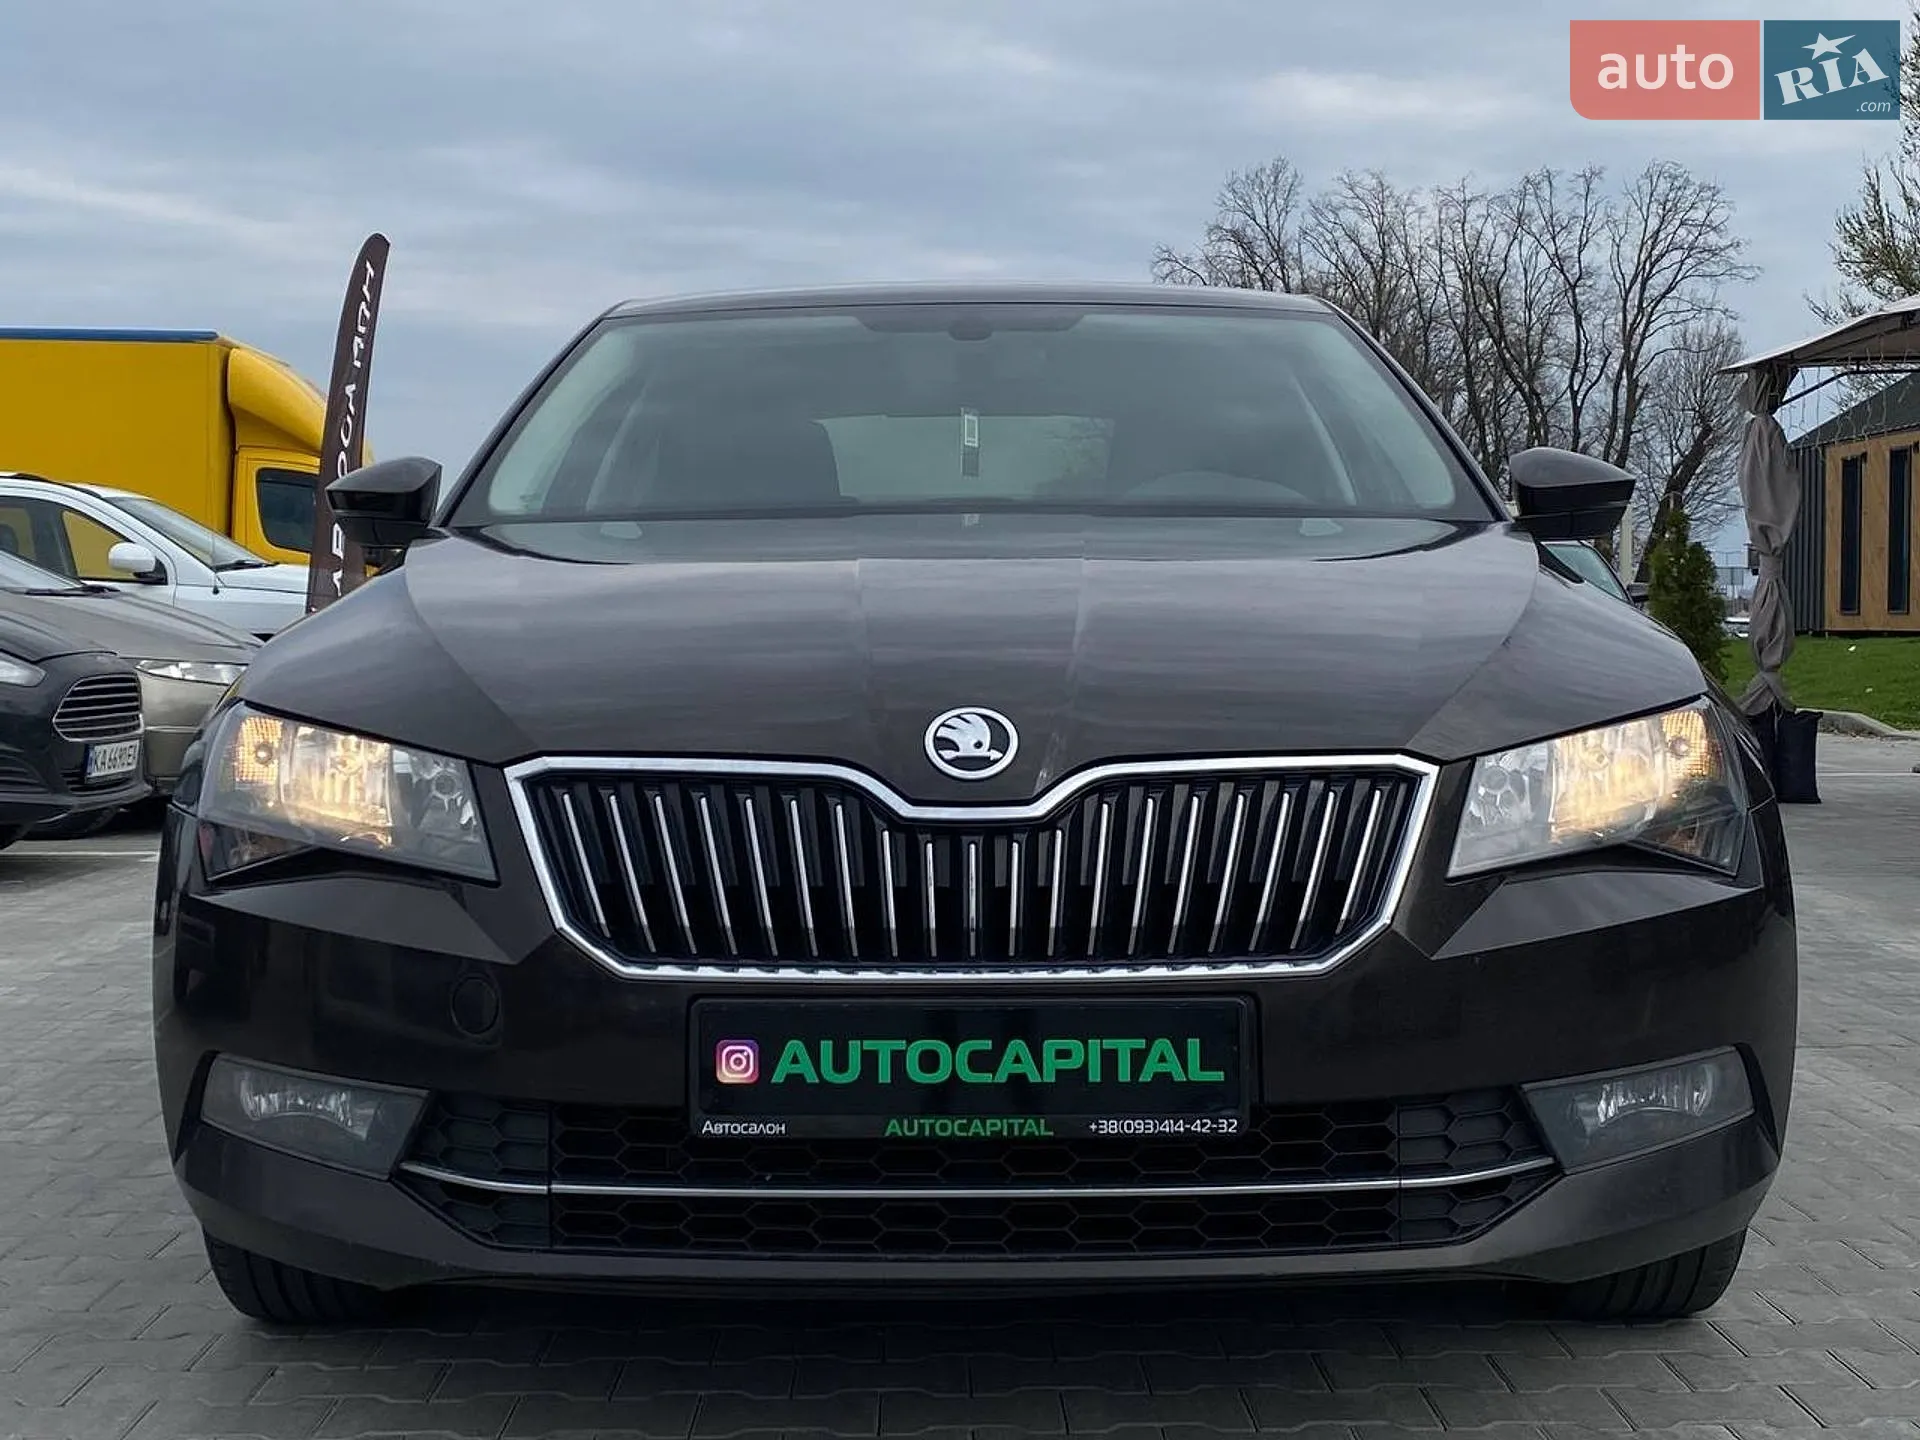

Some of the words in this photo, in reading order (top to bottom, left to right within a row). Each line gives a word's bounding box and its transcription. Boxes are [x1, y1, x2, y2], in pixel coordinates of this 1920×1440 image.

[771, 1038, 1225, 1084] AUTOCAPITAL
[702, 1119, 786, 1136] Автосалон
[884, 1118, 1054, 1138] AUTOCAPITAL
[1089, 1119, 1239, 1138] +38(093)414-42-32
